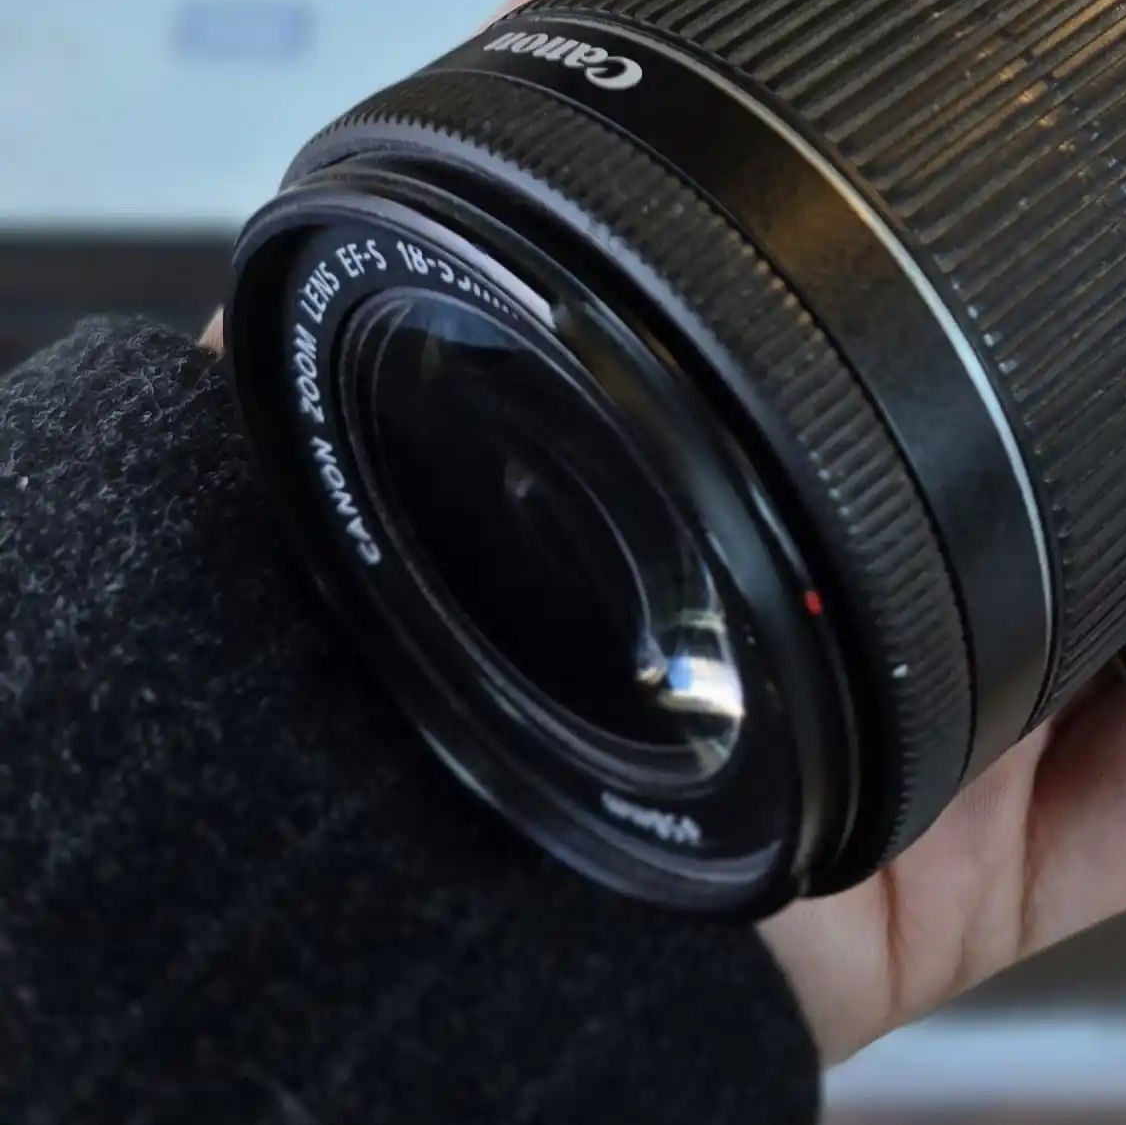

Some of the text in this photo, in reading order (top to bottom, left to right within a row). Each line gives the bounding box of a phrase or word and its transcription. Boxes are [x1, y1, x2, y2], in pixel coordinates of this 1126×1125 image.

[483, 32, 643, 90] Canon
[335, 239, 387, 279] EF-S
[300, 261, 341, 325] LENS
[291, 324, 325, 424] ZOOM
[309, 436, 382, 565] CANON
